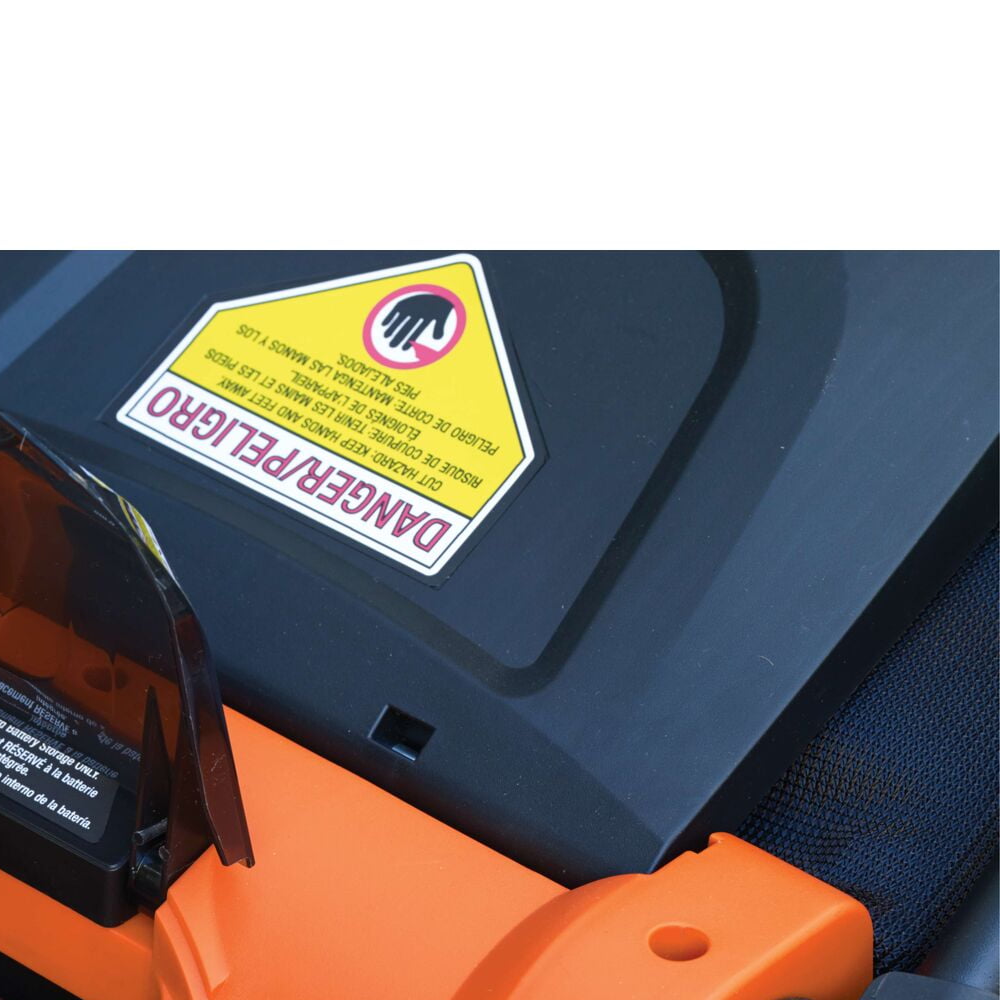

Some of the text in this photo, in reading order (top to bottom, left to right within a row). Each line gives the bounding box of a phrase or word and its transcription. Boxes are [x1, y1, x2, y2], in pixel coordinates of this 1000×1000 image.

[236, 324, 500, 456] PELIGRO DE CORTE: MANTENGA LAS MANOS Y LOS
[247, 392, 278, 412] FEET
[392, 381, 421, 400] PIES
[204, 348, 484, 489] RISQUE DE COUPURE: TENIR LES MAINS ET LES PIEDS
[276, 405, 304, 423] AND
[347, 399, 368, 415] DE
[300, 417, 342, 443] HANDS
[339, 438, 371, 457] KEEP
[146, 386, 452, 553] DANGER/PELIGRO
[370, 450, 420, 480] HAZARD:
[416, 474, 443, 492] CUT
[1, 740, 48, 769] RÉSERVÉ
[42, 762, 53, 774] à
[50, 767, 63, 779] la
[60, 772, 98, 798] batterie
[0, 774, 35, 798] interno
[33, 793, 48, 805] de
[46, 799, 58, 811] la
[56, 804, 91, 830] batería.
